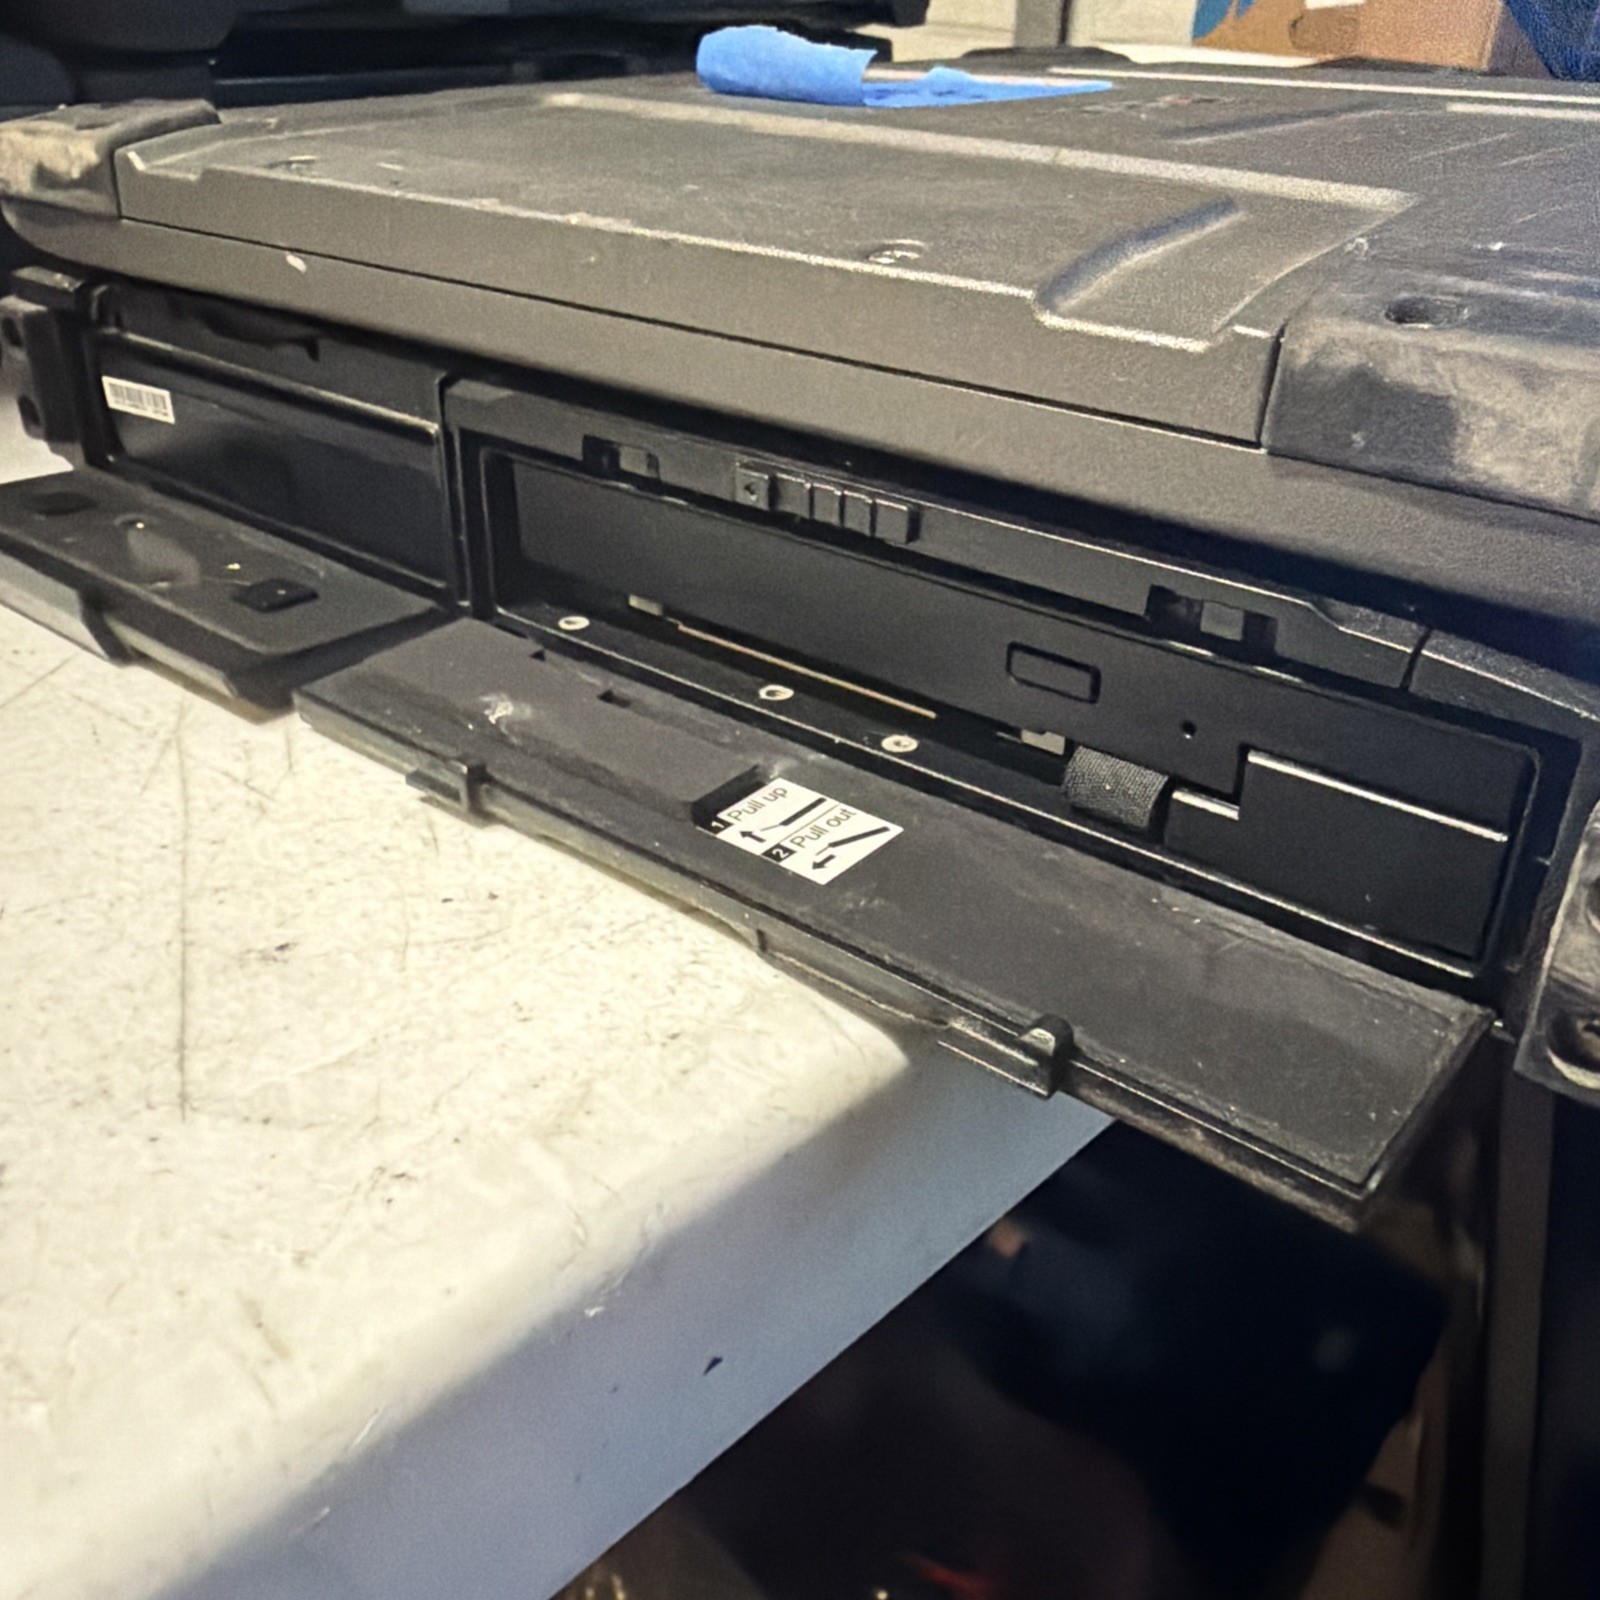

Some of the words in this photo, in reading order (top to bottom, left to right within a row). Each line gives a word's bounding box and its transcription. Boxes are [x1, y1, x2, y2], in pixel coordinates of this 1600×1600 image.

[711, 821, 725, 831] 1
[727, 798, 766, 822] Pull
[764, 786, 788, 803] up
[772, 848, 788, 860] 2
[790, 825, 828, 848] Pull
[826, 808, 857, 827] out
